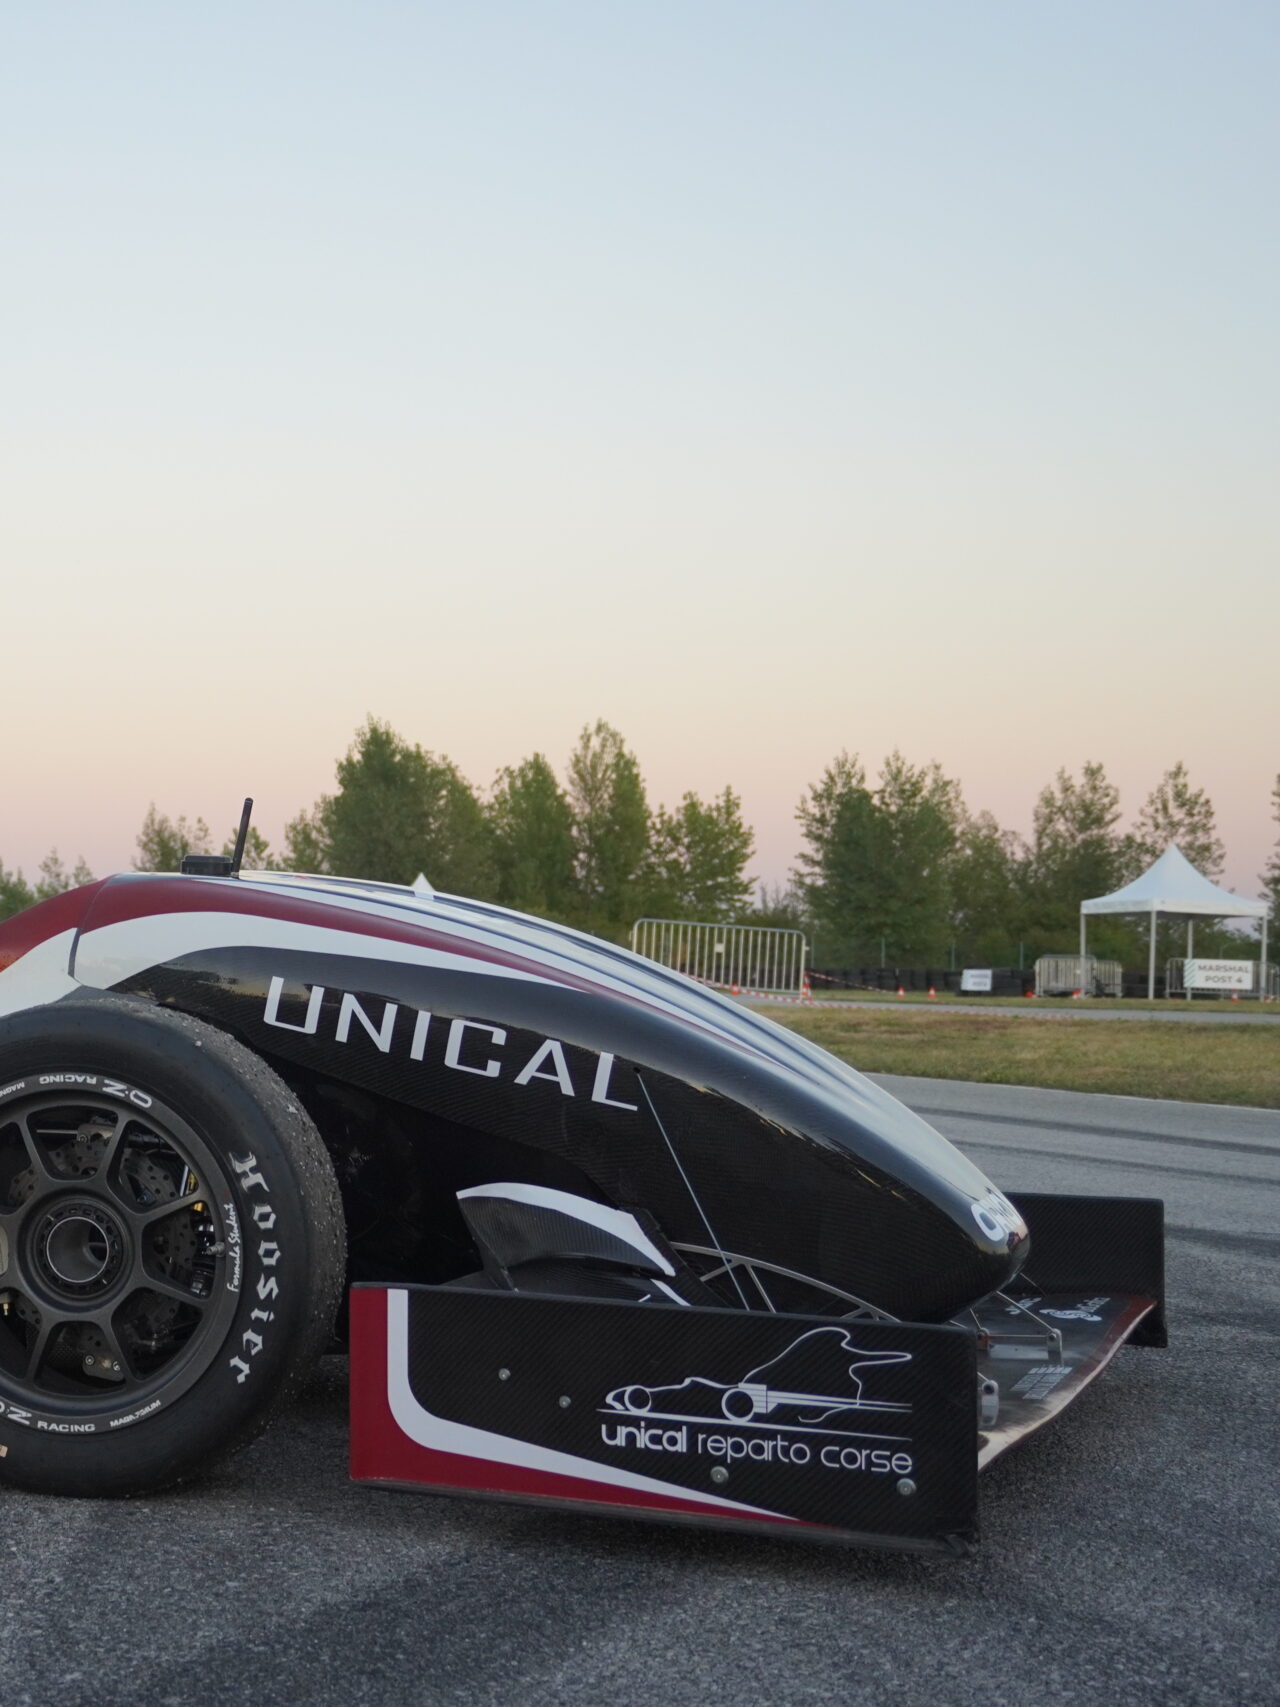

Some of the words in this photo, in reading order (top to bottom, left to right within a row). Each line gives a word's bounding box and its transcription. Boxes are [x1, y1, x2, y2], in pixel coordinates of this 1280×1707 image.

[1198, 965, 1249, 973] MARSHAL
[1205, 975, 1232, 983] POST
[263, 976, 638, 1111] UNICAL
[39, 1074, 97, 1084] RACING
[228, 1151, 281, 1384] Hoosier
[37, 1420, 96, 1432] RACING
[601, 1421, 687, 1453] unical
[698, 1434, 810, 1464] reparto
[821, 1446, 912, 1474] corse
